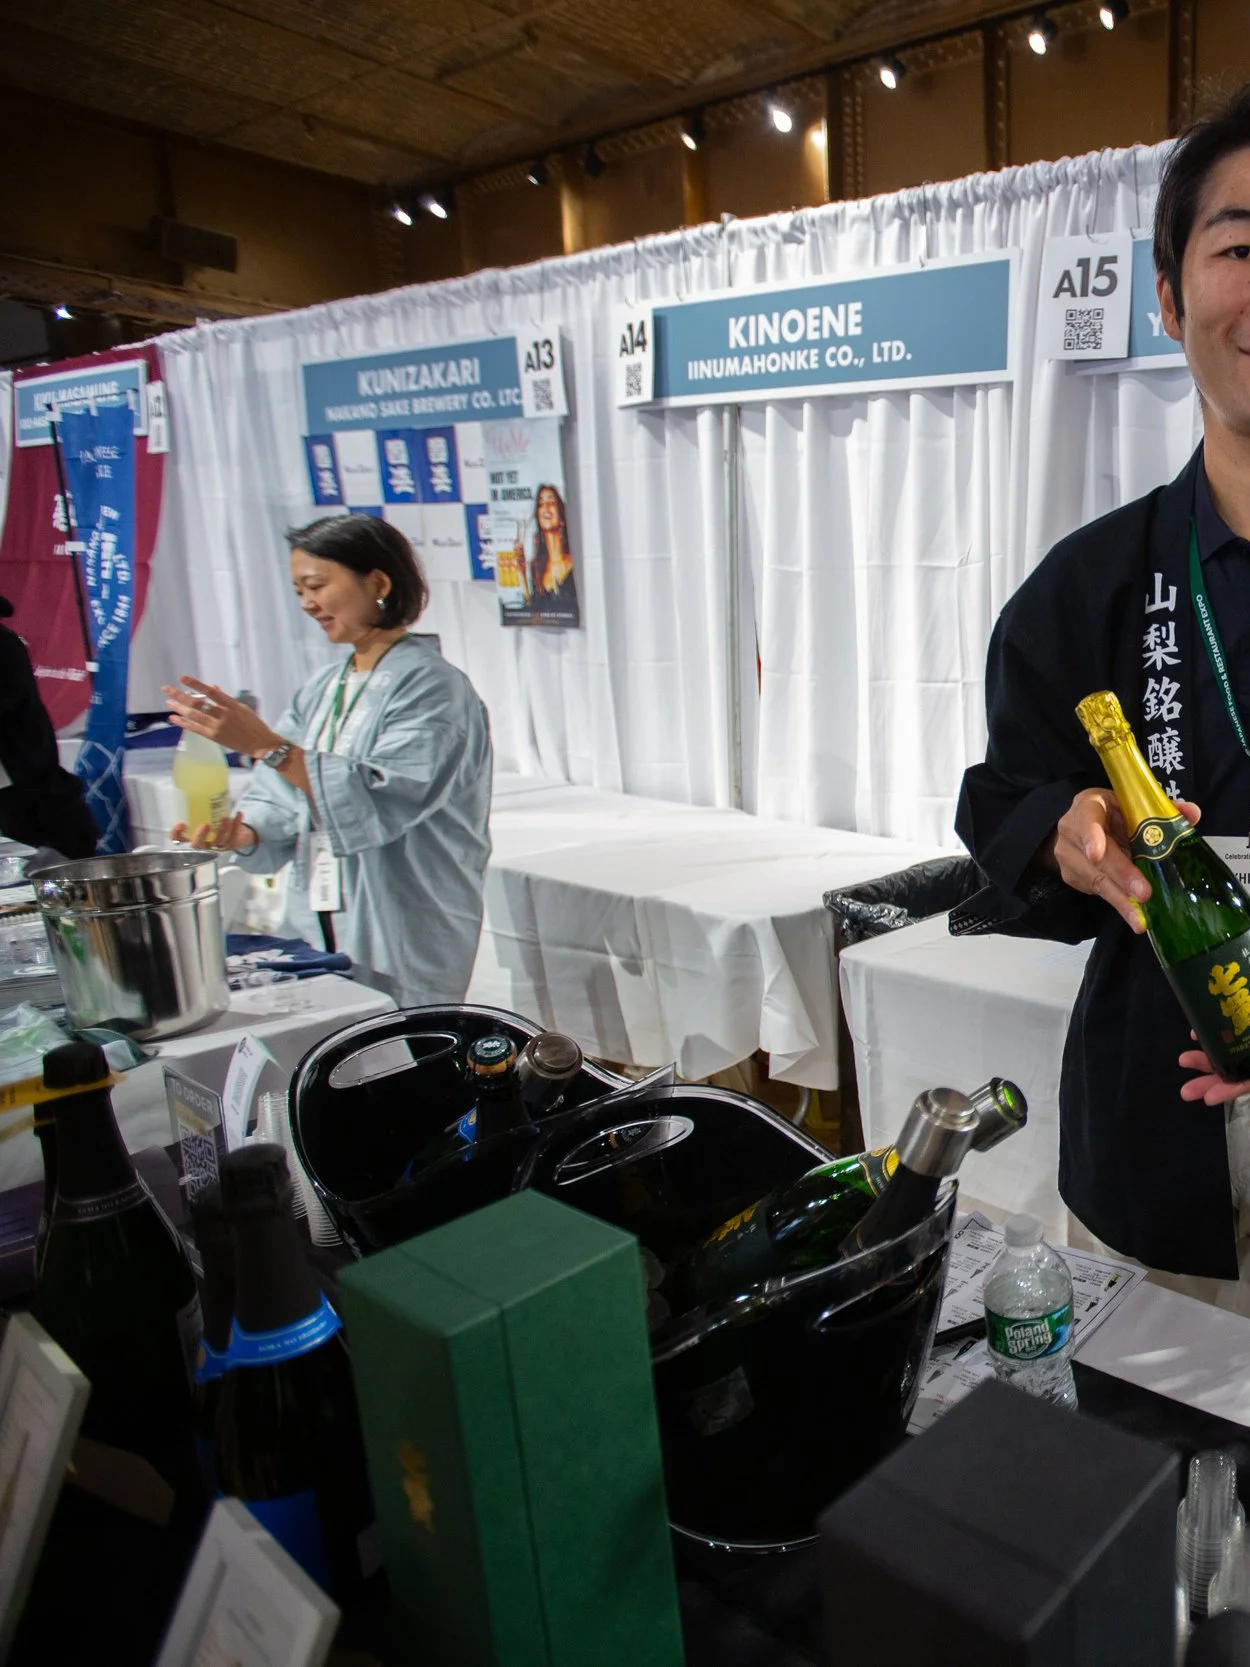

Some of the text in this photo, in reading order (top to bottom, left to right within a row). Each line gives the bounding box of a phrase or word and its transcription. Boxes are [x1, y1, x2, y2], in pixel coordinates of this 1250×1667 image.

[1052, 255, 1119, 299] A15
[619, 321, 648, 359] A14
[727, 302, 863, 349] KINOENE
[524, 339, 555, 373] A13
[687, 340, 913, 380] IINUMAHONKE CO., LTD.
[357, 357, 481, 397] KUNIZAKARI
[325, 404, 378, 422] NAKANO
[379, 401, 410, 418] SAKE
[412, 394, 468, 415] BREWERY
[1196, 593, 1209, 619] EXPO
[1203, 618, 1225, 673] RESTAURANT
[1223, 680, 1233, 706] FOOD
[182, 1085, 215, 1115] ORDER
[1004, 1317, 1049, 1340] Poland
[1007, 1331, 1053, 1355] Spring
